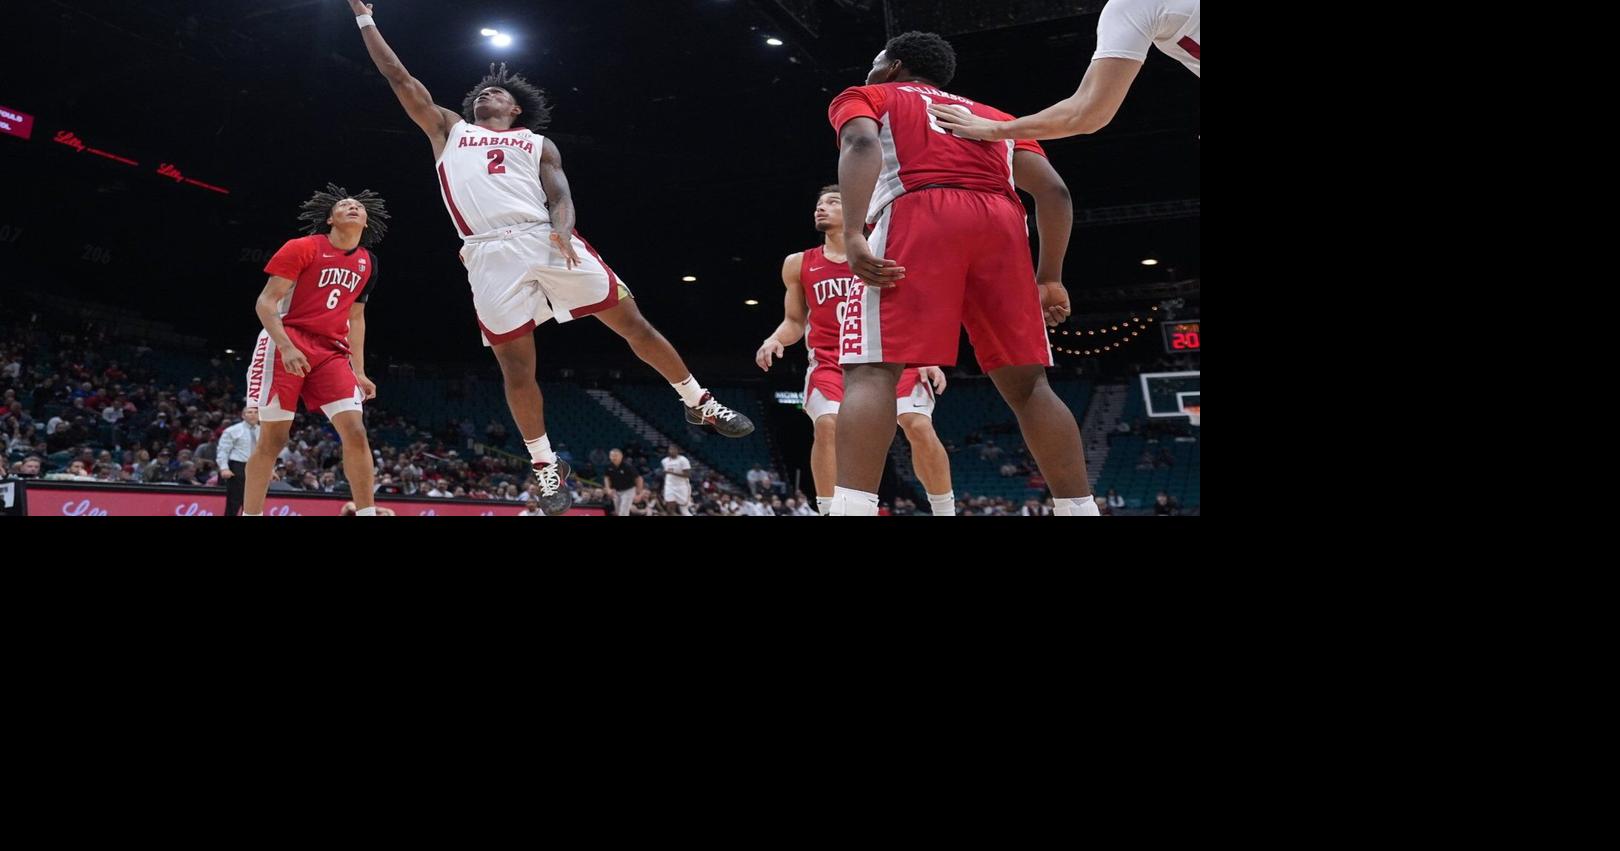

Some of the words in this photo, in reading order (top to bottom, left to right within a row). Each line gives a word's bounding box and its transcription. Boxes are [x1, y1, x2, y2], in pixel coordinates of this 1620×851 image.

[458, 136, 534, 154] ALABAMA
[487, 149, 506, 175] 2
[318, 267, 361, 293] UNLV
[326, 288, 341, 310] 6
